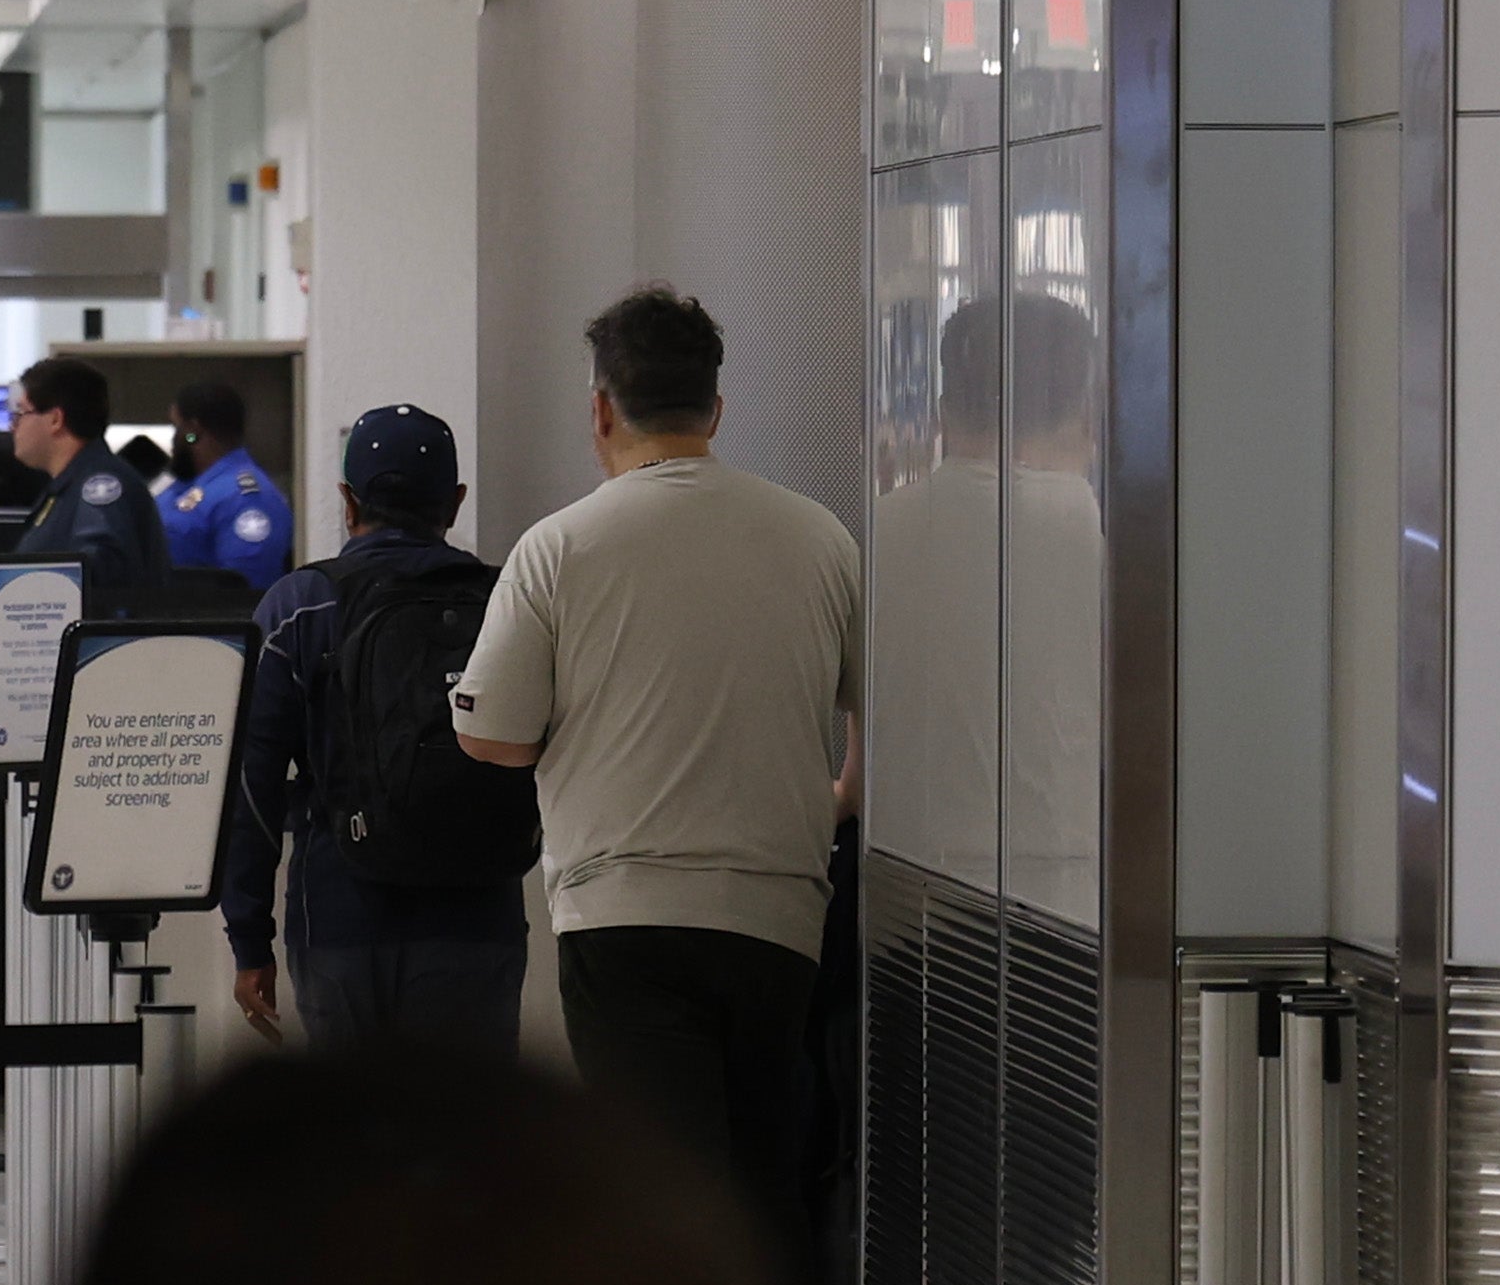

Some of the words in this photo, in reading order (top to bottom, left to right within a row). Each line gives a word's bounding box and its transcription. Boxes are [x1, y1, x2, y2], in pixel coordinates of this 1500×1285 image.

[86, 714, 111, 728] You
[114, 716, 136, 728] are
[139, 712, 196, 729] entering
[198, 714, 215, 727] an
[72, 736, 101, 748] area
[106, 733, 148, 747] where
[151, 732, 167, 746] all
[171, 733, 223, 748] persons
[88, 753, 113, 767] and
[117, 753, 176, 769] property
[179, 753, 201, 765] are
[74, 772, 122, 789] subject
[126, 773, 139, 787] to
[142, 771, 210, 786] additional
[105, 792, 171, 807] screening.
